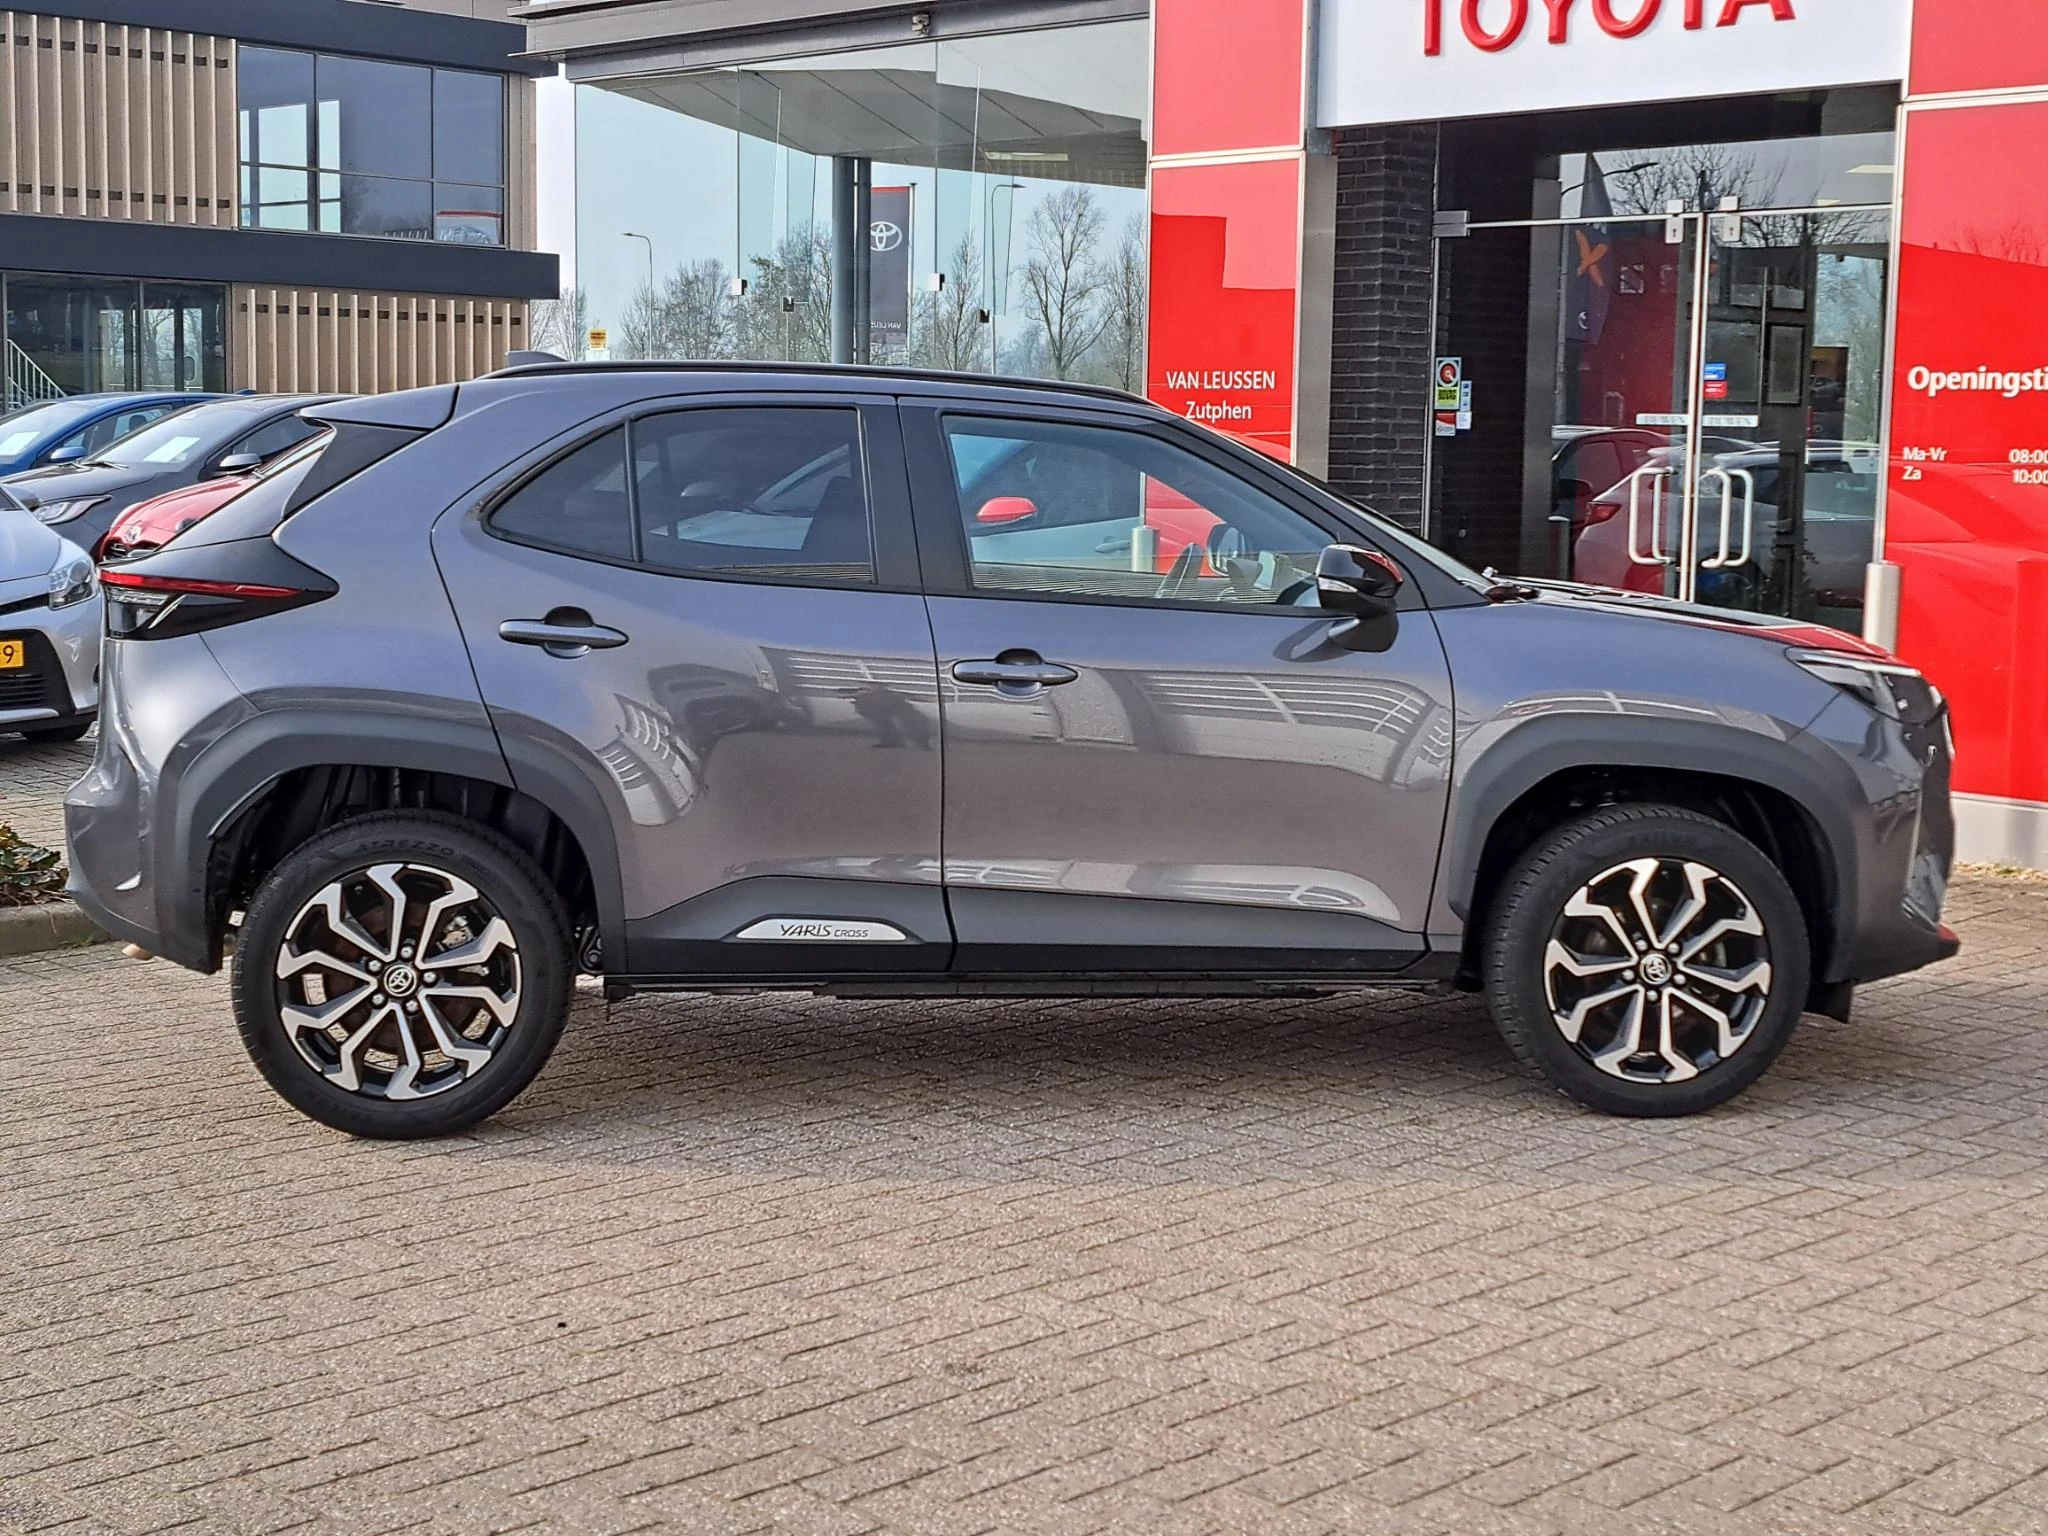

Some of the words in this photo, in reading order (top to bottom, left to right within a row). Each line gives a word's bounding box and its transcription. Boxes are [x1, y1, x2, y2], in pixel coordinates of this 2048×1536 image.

[1166, 370, 1199, 389] VAN
[1203, 370, 1275, 389] LEUSSEN
[1185, 400, 1252, 424] Zutphen
[1902, 446, 1948, 461] Ma-Vr
[1902, 466, 1922, 480] Za
[780, 924, 833, 937] YARIS
[833, 929, 869, 938] CROSS
